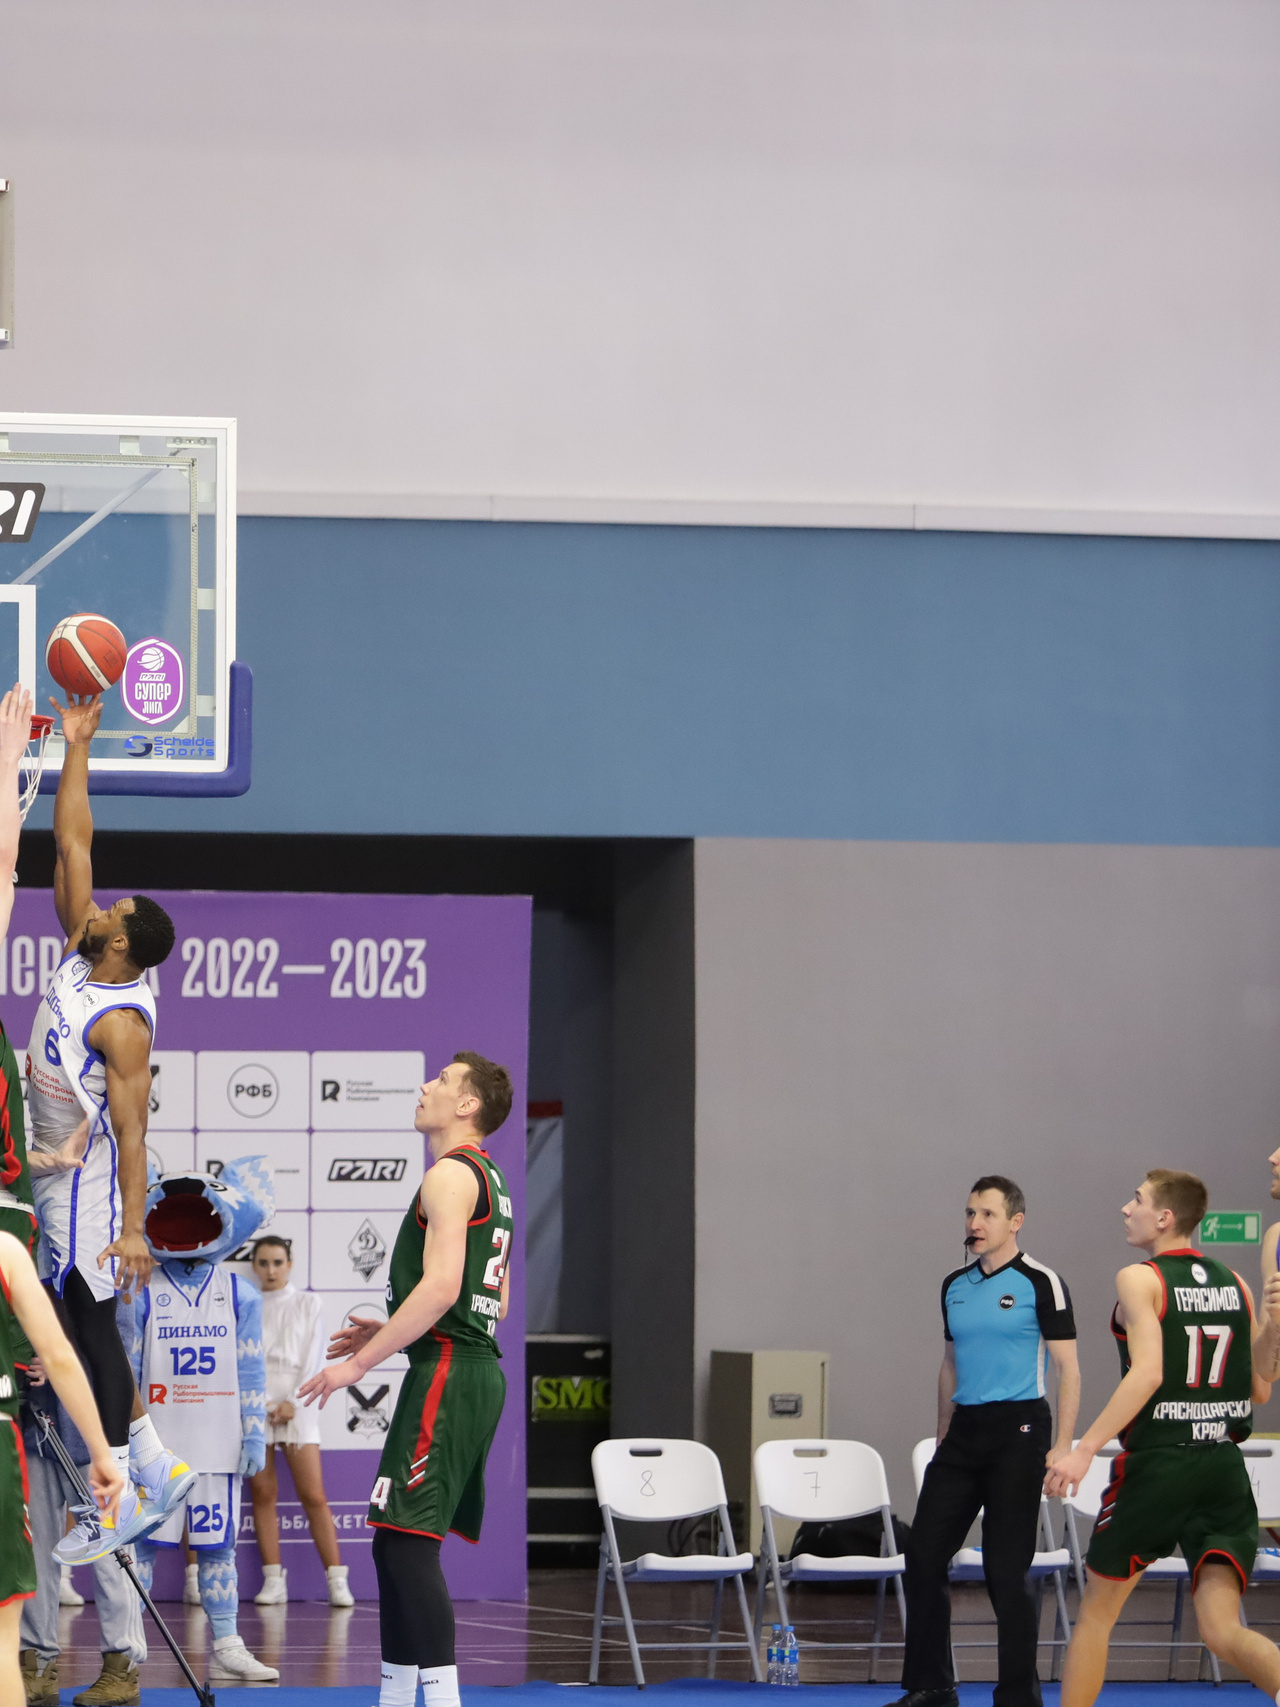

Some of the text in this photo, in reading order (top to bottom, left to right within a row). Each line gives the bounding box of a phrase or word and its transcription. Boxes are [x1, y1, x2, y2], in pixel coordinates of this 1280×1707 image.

[139, 673, 166, 682] PARI
[142, 701, 163, 714] ЛИГА
[153, 735, 215, 747] Schelde
[153, 747, 215, 759] Sports
[44, 1027, 62, 1067] 6
[235, 1084, 273, 1098] РФБ
[329, 1160, 406, 1181] PARI
[1173, 1285, 1241, 1312] ГЕРАСИМОВ
[157, 1325, 228, 1340] ДИНАМО
[170, 1346, 216, 1376] 125
[1183, 1325, 1234, 1388] 17
[1152, 1397, 1252, 1420] КРАСНОДАРСКИ
[1191, 1420, 1227, 1440] КРАЙ
[639, 1470, 657, 1497] 8
[803, 1471, 822, 1498] 7
[186, 1503, 224, 1534] 125
